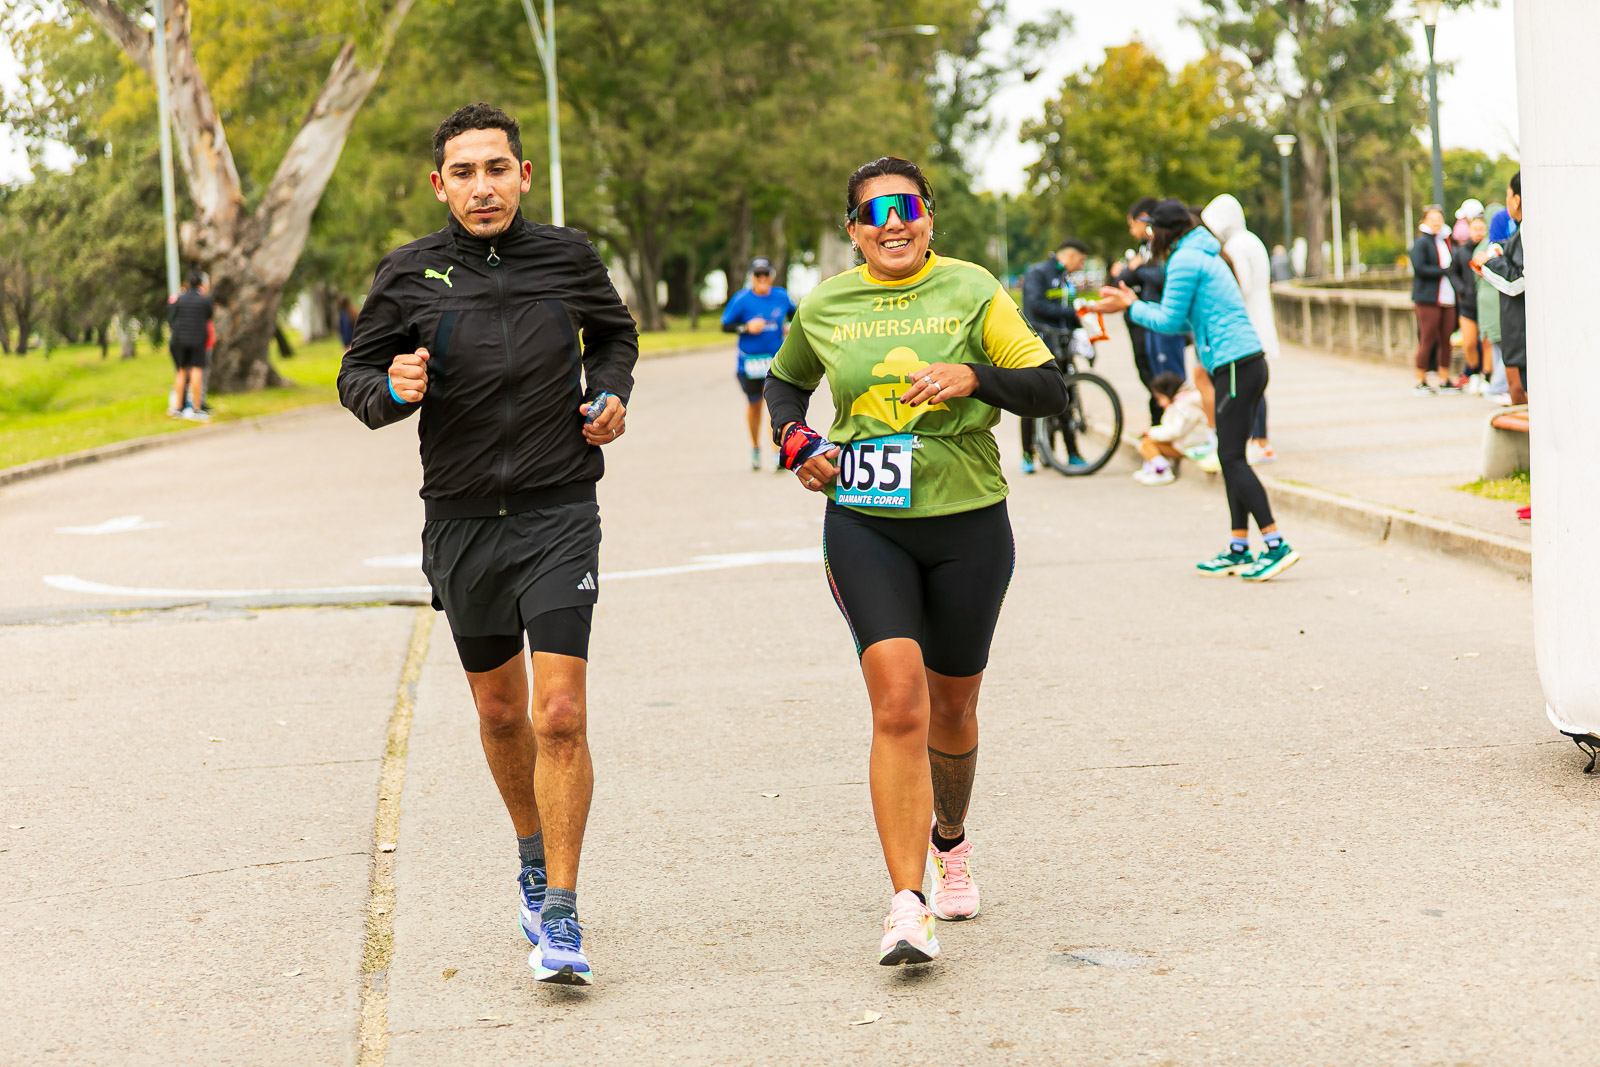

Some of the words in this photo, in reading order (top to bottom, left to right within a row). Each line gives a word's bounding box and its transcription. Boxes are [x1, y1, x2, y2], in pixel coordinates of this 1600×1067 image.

[830, 316, 961, 344] ANIVERSARIO
[840, 442, 902, 492] 055
[838, 494, 873, 505] DIAMANTE
[873, 495, 906, 506] CORRE
